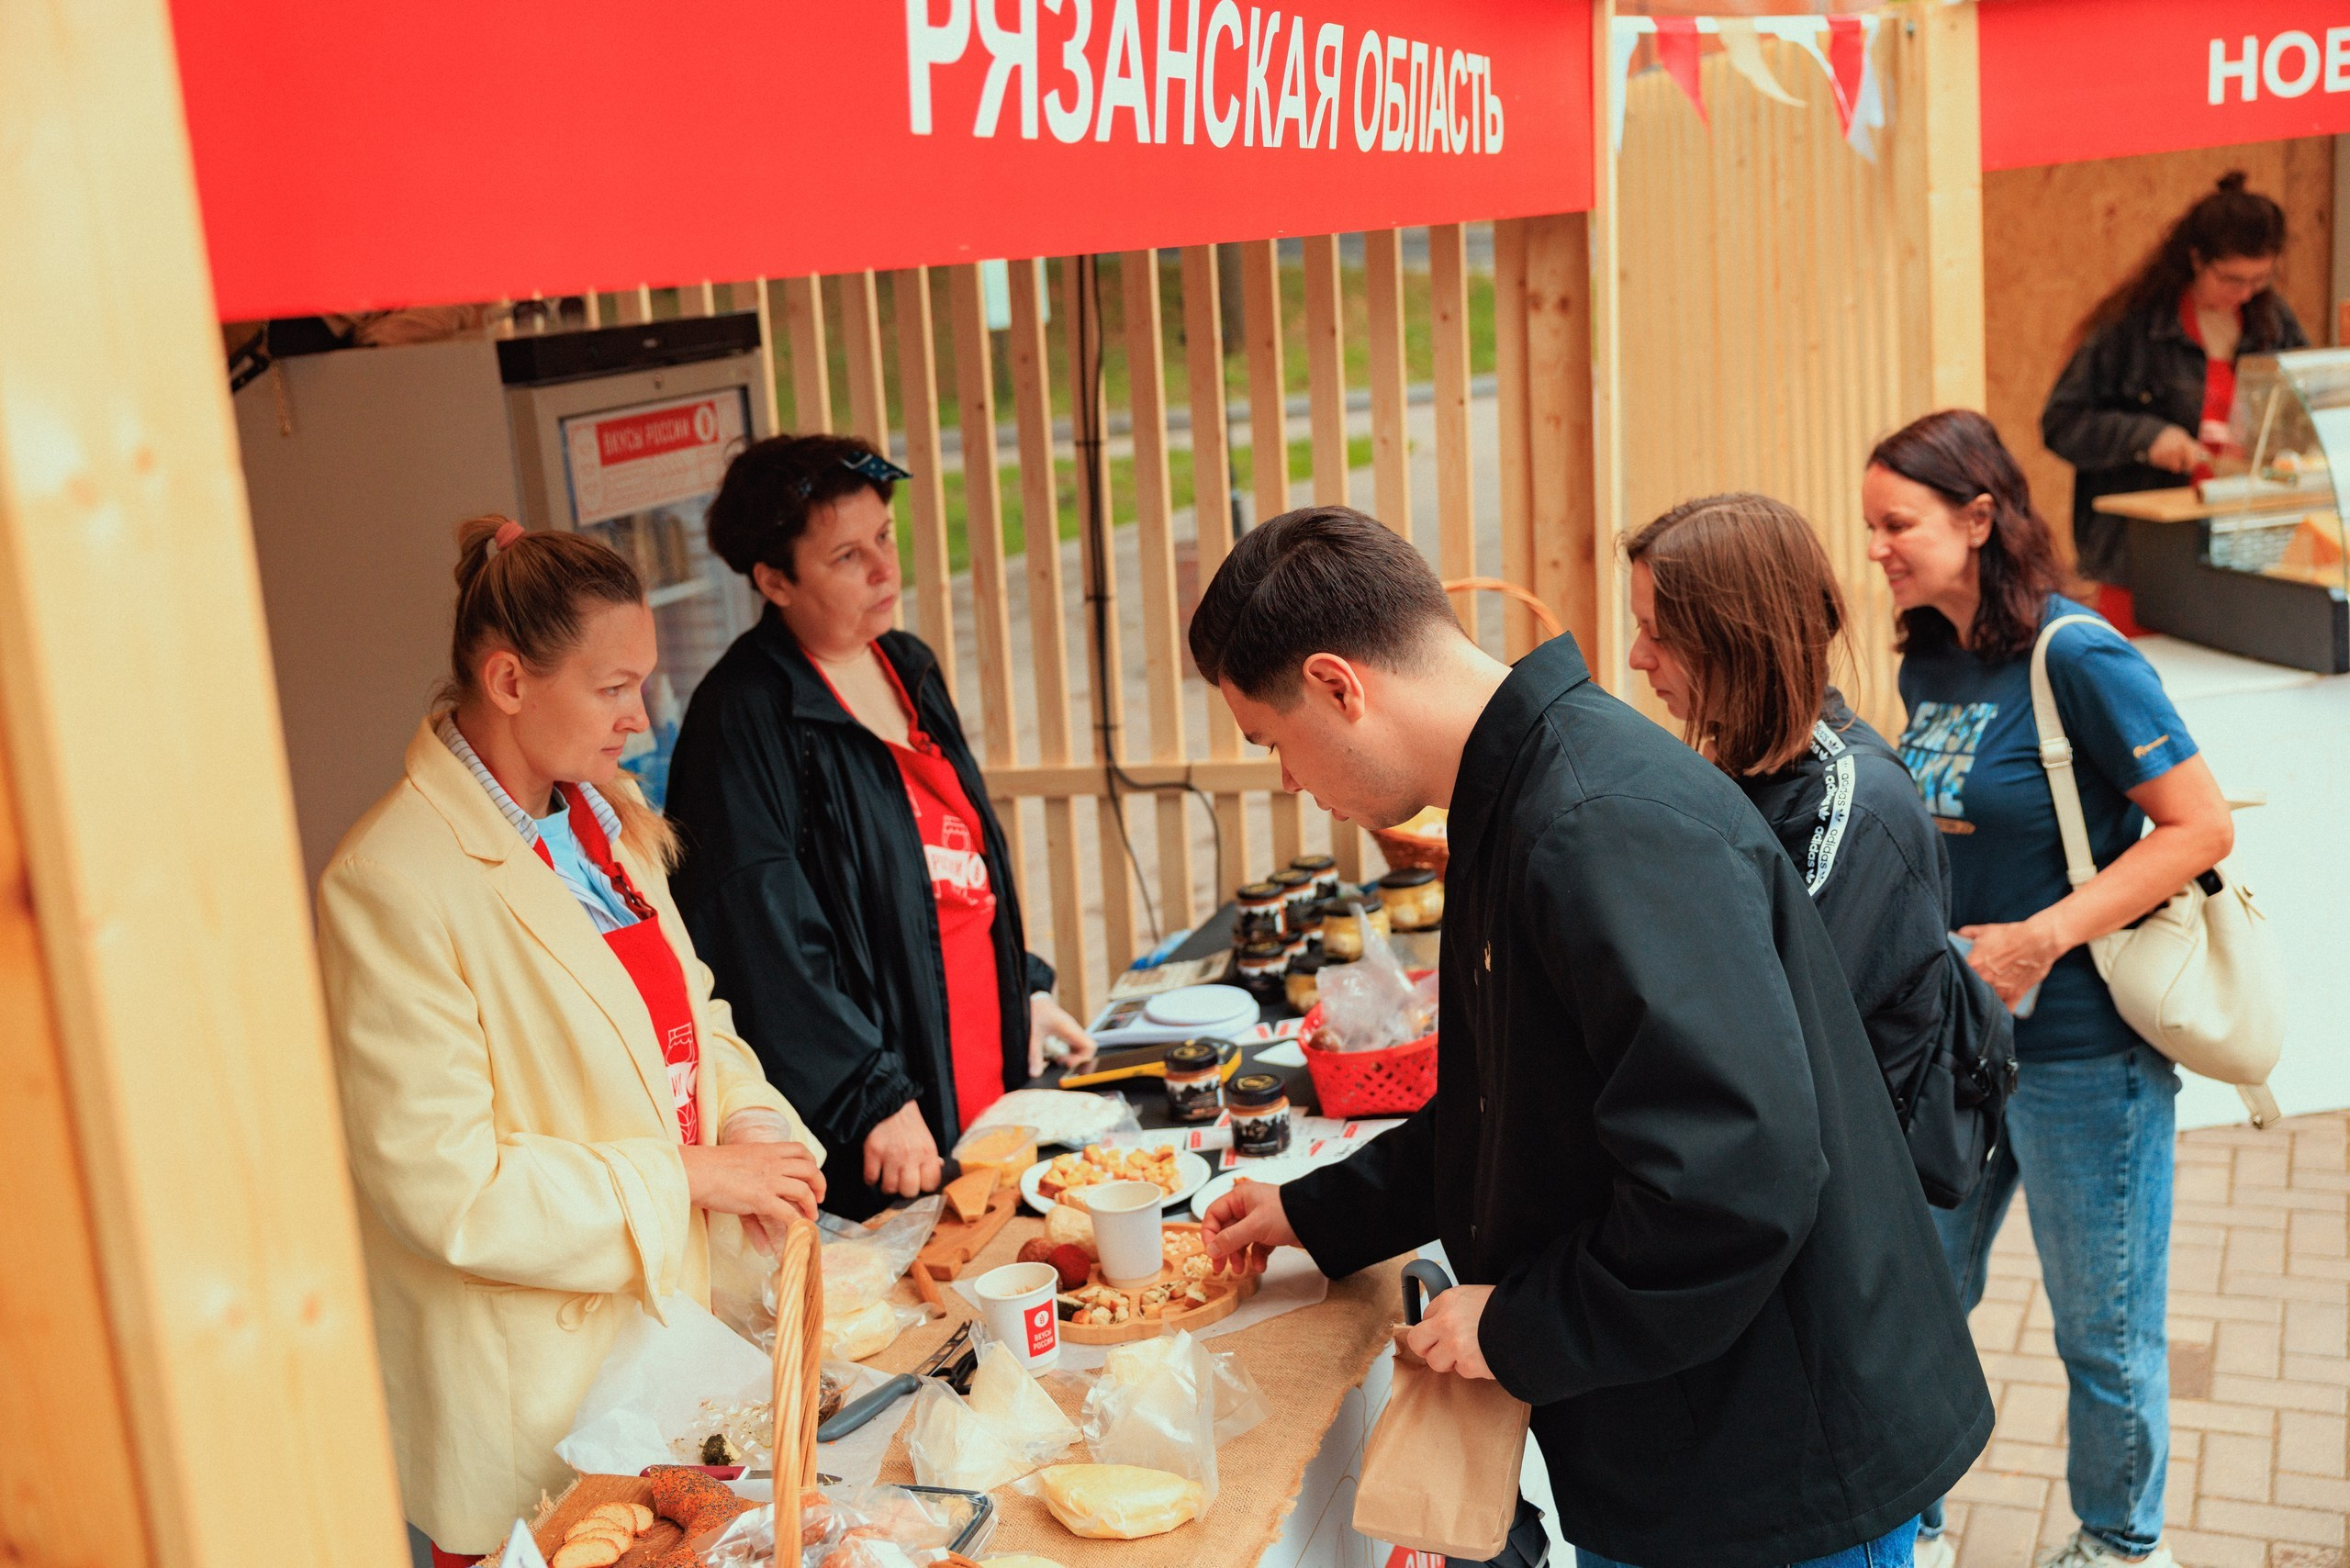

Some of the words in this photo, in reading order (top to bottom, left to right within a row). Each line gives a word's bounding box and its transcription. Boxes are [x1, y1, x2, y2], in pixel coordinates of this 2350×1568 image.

[905, 0, 1345, 150] РЯЗАНСКАЯ
[1353, 28, 1505, 155] ОБЛАСТЬ
[1807, 825, 1825, 868] adidas
[1820, 828, 1838, 869] adidas
[1033, 1336, 1054, 1350] РОССИИ
[1034, 1327, 1052, 1342] ВКУСЫ
